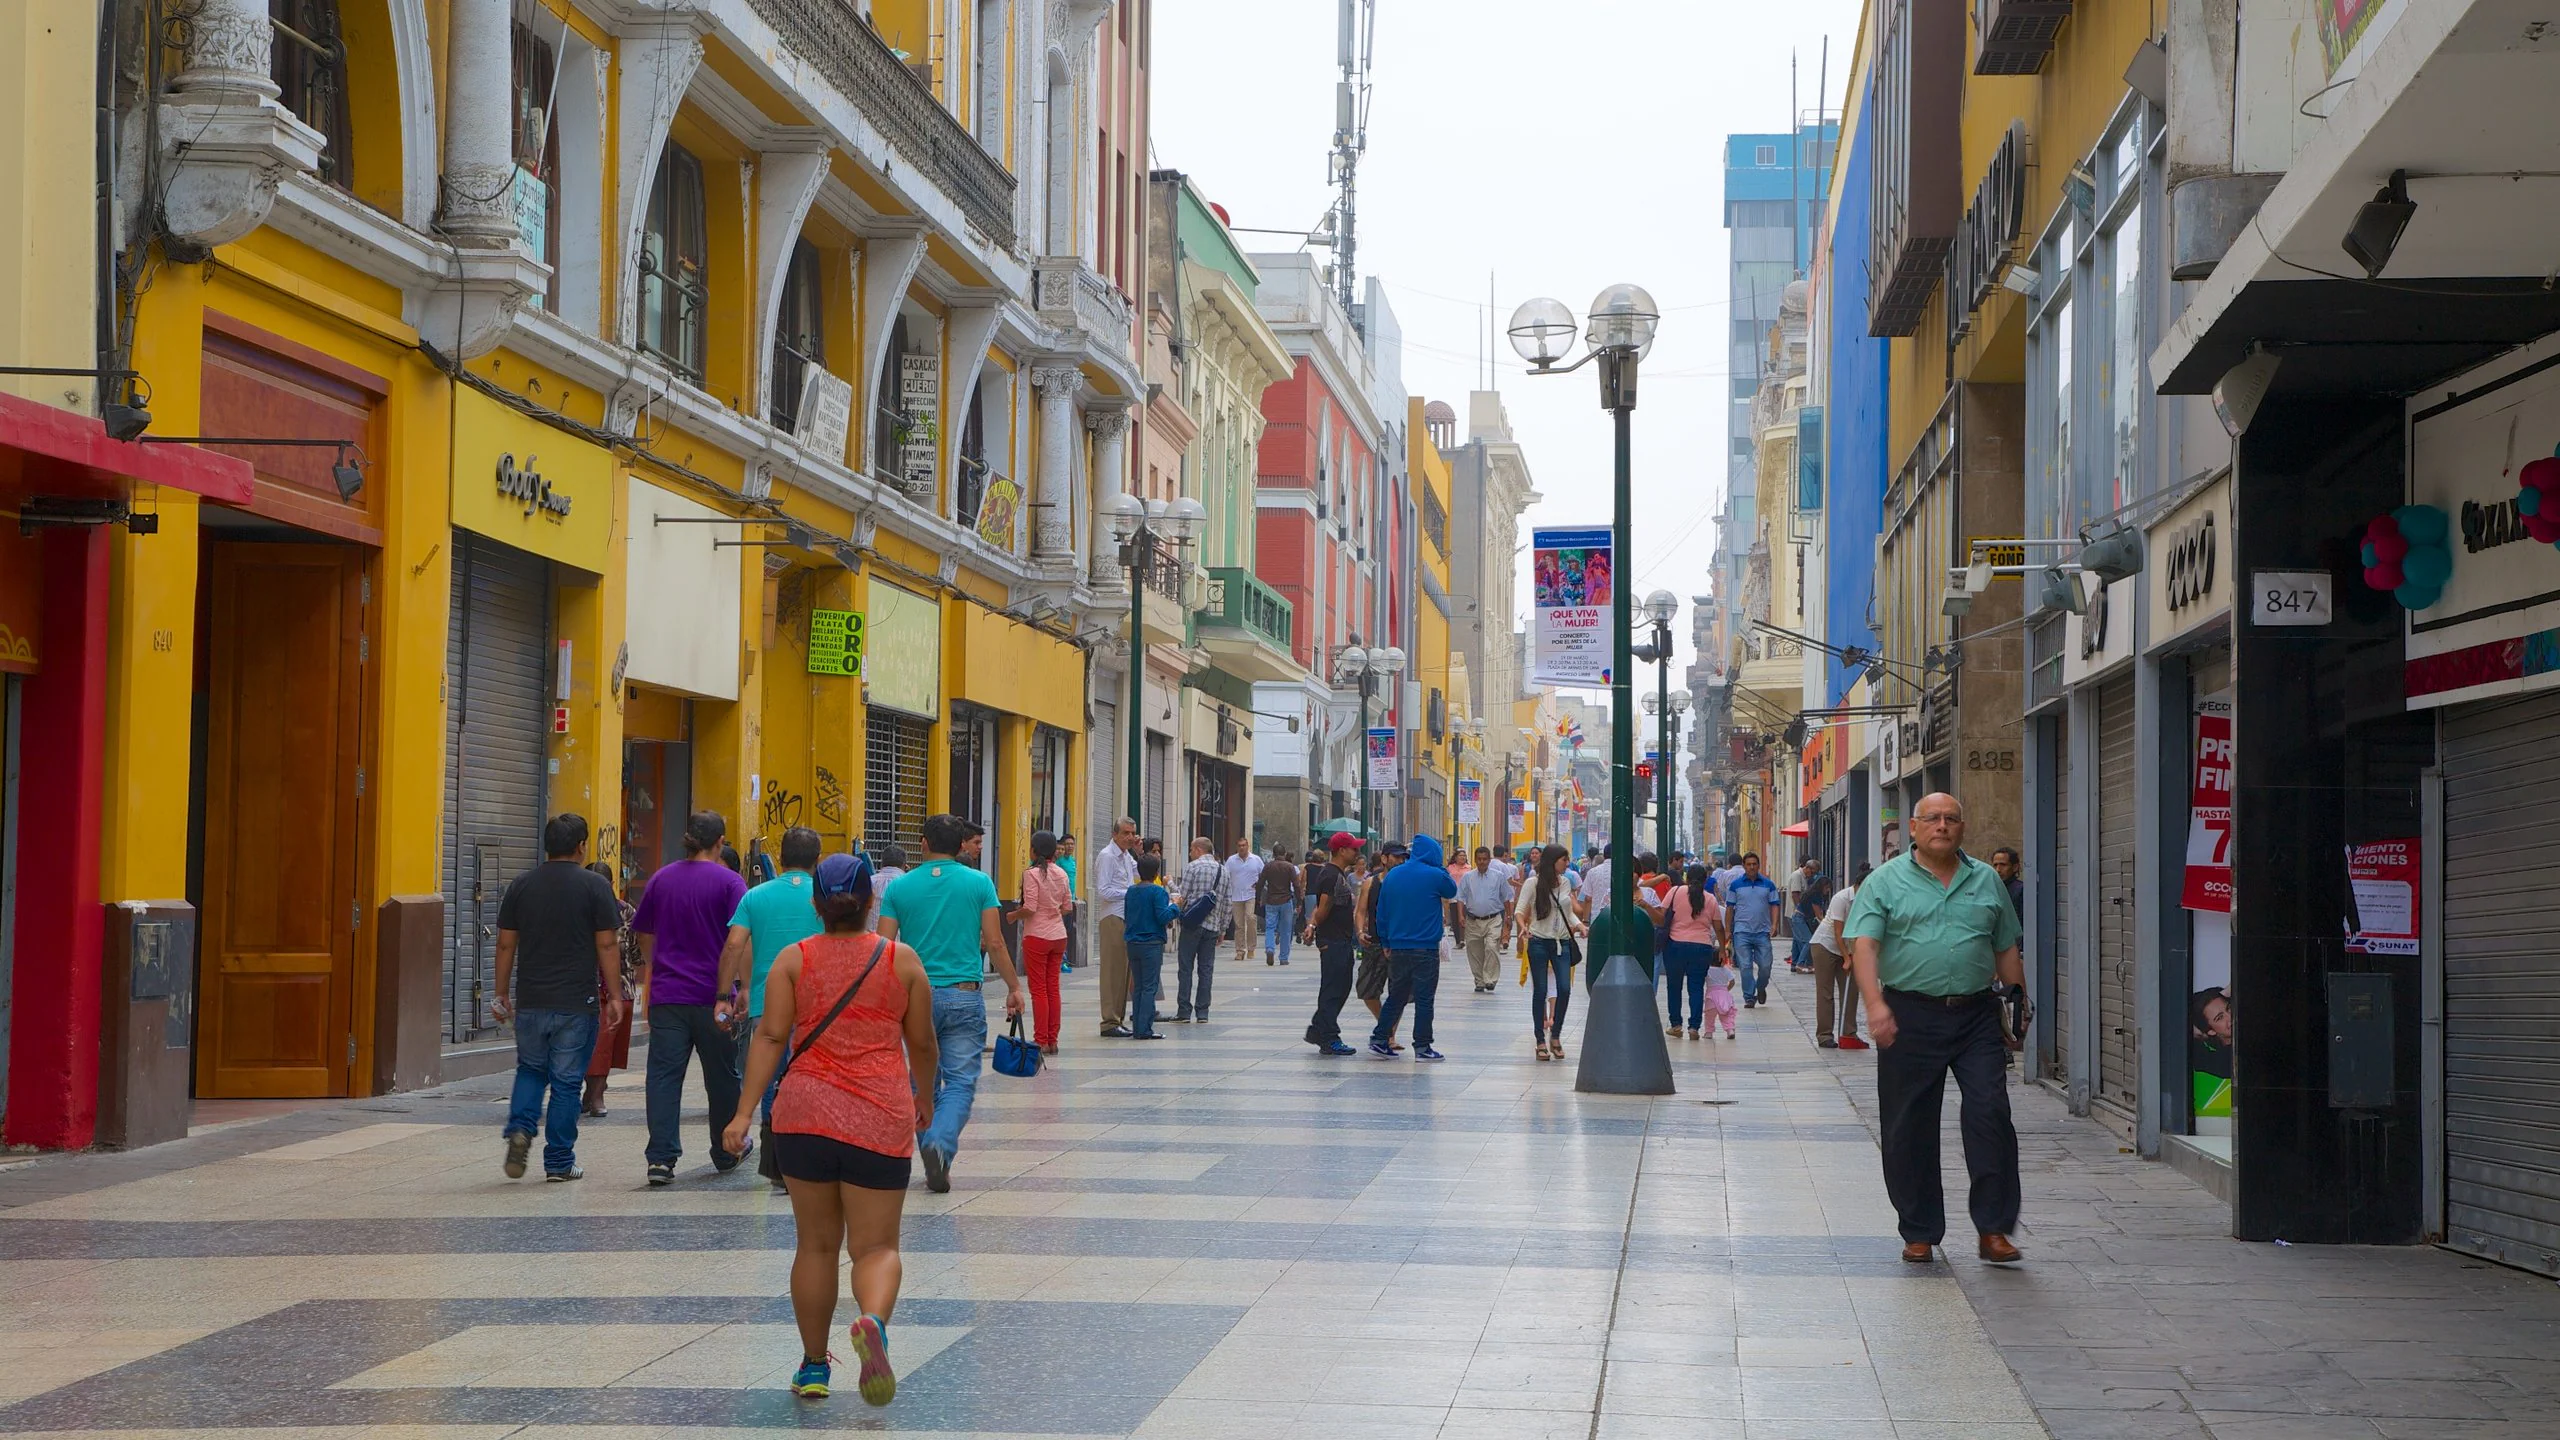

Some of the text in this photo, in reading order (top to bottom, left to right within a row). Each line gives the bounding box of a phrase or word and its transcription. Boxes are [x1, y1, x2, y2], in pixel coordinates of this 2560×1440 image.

[903, 358, 936, 372] CASACAS
[914, 371, 925, 379] DE
[903, 379, 936, 394] CUERO
[2266, 589, 2319, 613] 847
[813, 612, 846, 620] JOYERIA
[1550, 609, 1599, 621] ¡QUE VIVA
[815, 620, 843, 628] PLATA
[1565, 619, 1599, 628] MUJER!
[152, 629, 174, 652] 840
[842, 614, 862, 673] ORO
[810, 664, 839, 673] GRATIS
[1968, 750, 2014, 771] 835
[2195, 810, 2231, 819] HASTA
